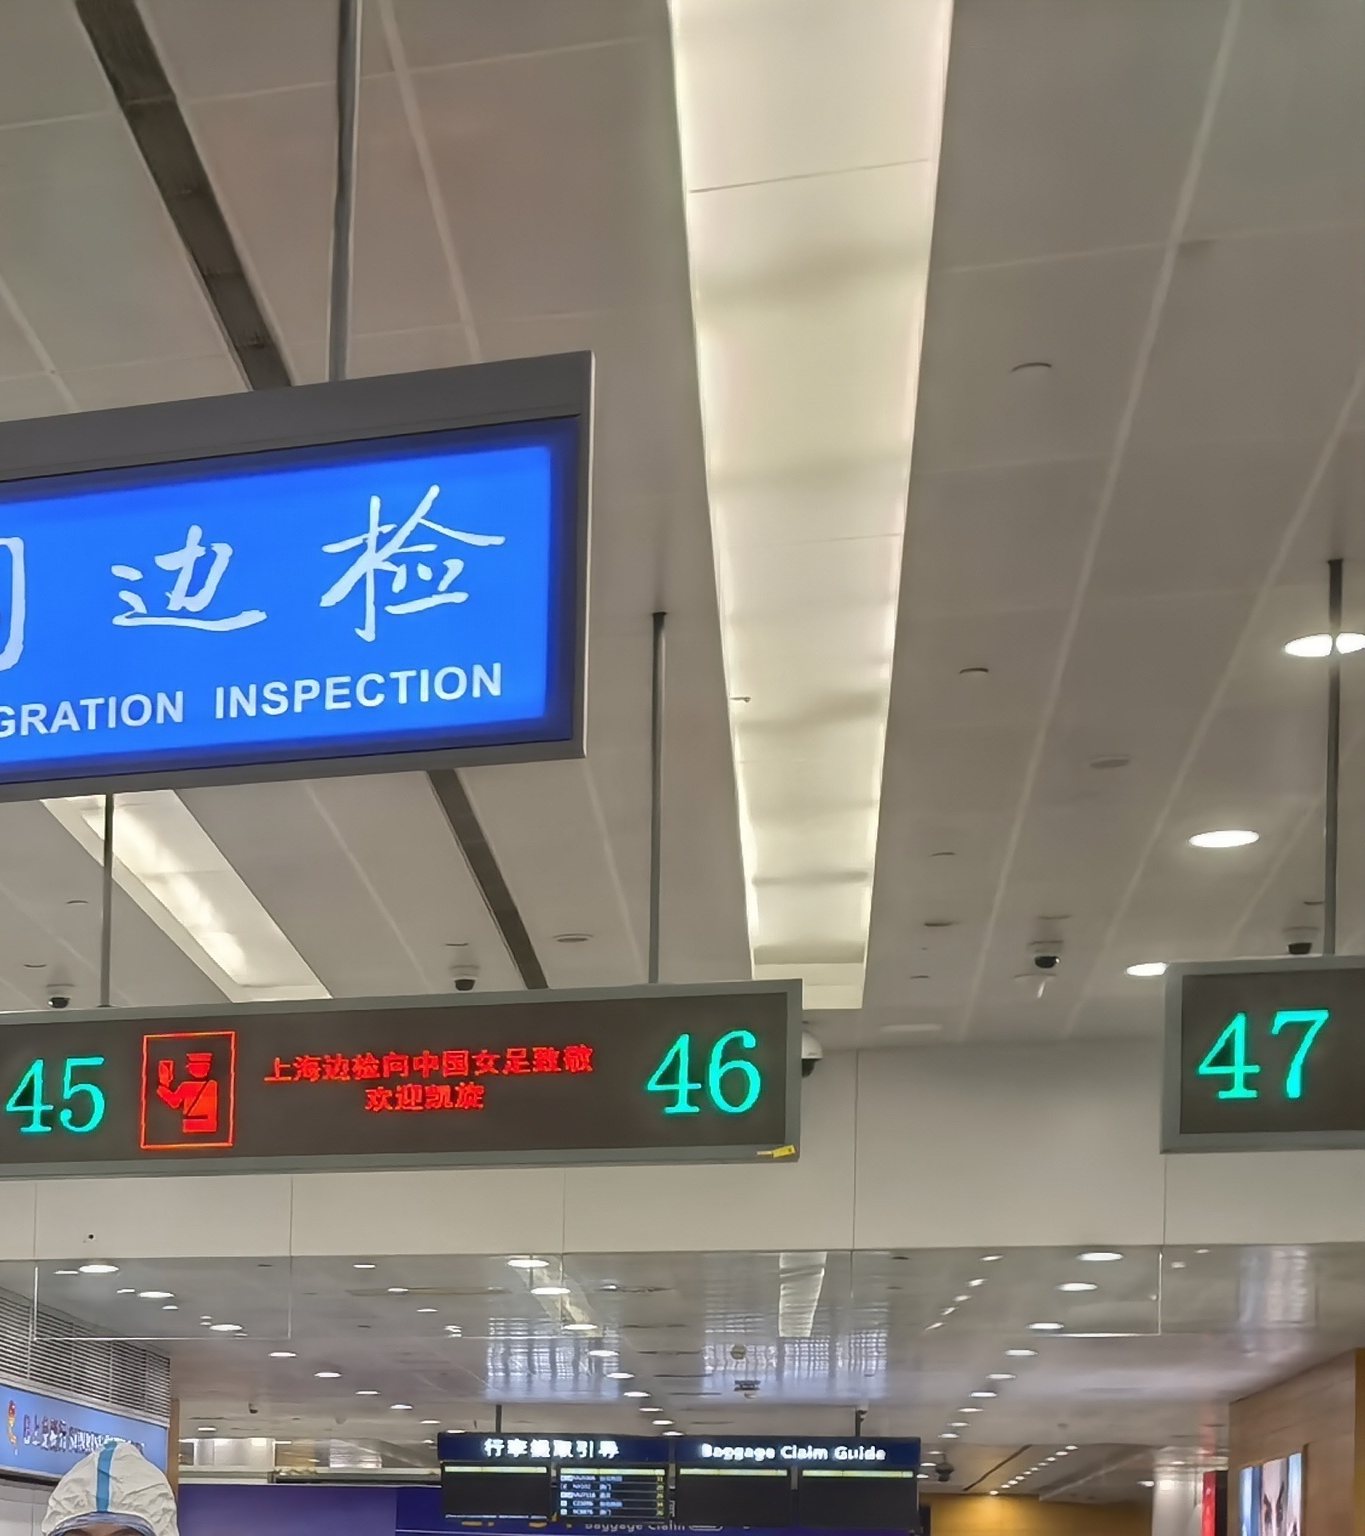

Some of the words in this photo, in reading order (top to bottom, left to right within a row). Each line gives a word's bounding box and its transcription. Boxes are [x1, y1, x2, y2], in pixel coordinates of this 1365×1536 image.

[214, 663, 504, 718] INSPECTION
[264, 1043, 594, 1083] 上海边检向中国女足致敬
[646, 1029, 762, 1115] 46
[1195, 1007, 1331, 1101] 47
[5, 1056, 106, 1134] 45
[364, 1083, 486, 1113] 欢迎凯旋
[701, 1443, 775, 1462] Baggage
[781, 1445, 828, 1460] Claim
[834, 1446, 886, 1461] Guide
